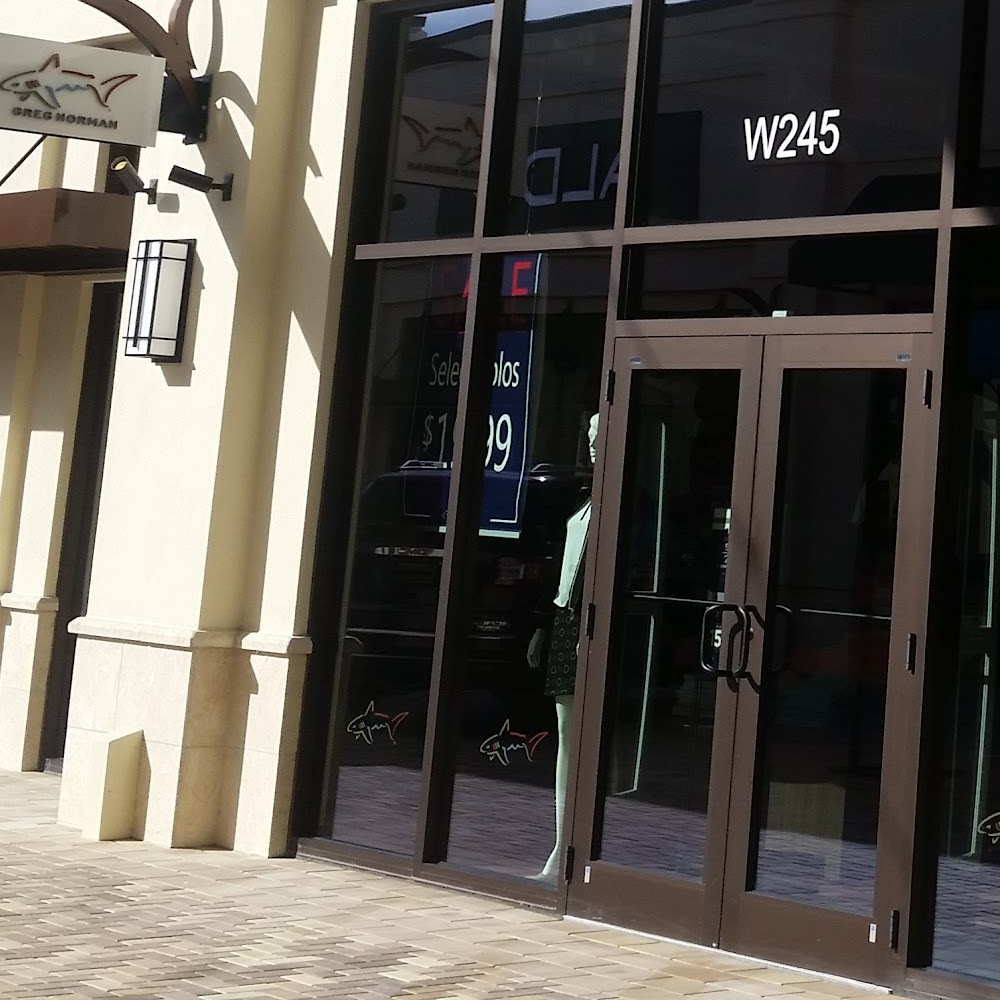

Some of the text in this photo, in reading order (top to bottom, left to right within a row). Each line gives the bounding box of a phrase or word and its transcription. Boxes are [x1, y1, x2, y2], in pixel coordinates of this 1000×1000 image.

[12, 106, 118, 130] GREG NORMAN
[743, 108, 841, 162] W245
